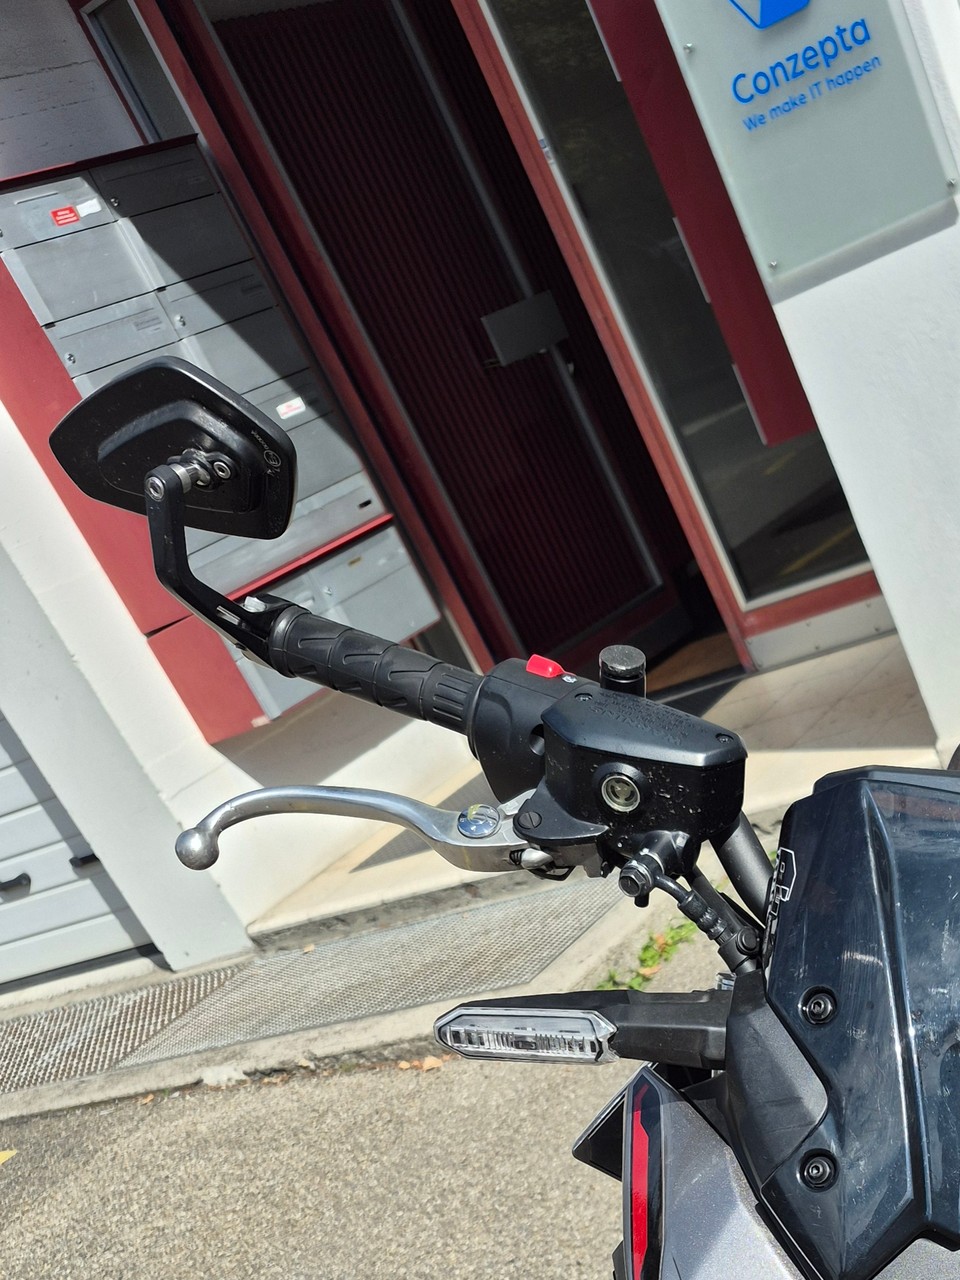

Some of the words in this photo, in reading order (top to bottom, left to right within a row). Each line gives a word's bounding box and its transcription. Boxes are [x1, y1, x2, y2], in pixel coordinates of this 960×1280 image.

[731, 18, 871, 103] Conzepta
[742, 114, 767, 131] We
[769, 93, 807, 119] make
[808, 81, 822, 99] IT
[826, 56, 882, 90] happen
